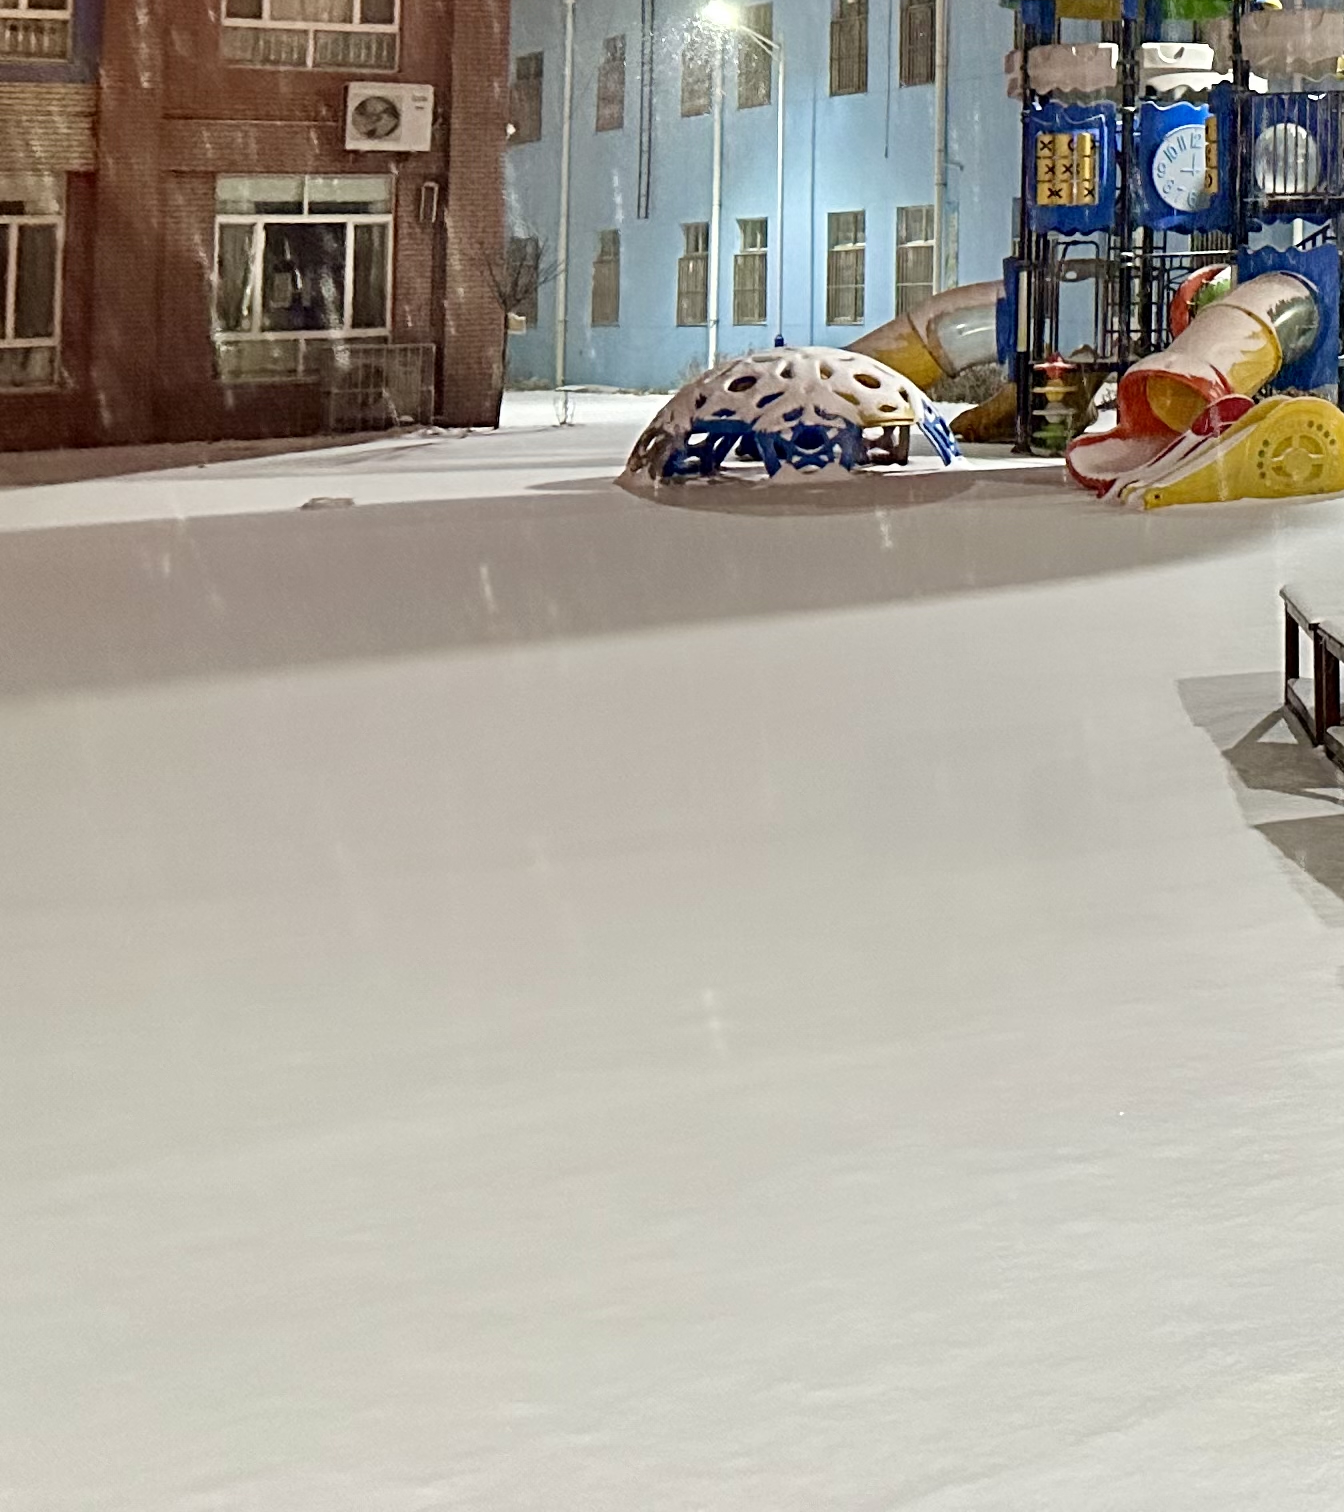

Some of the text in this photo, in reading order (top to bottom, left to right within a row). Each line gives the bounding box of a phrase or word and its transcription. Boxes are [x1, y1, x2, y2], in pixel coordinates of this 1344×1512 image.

[1176, 135, 1187, 152] 11
[1190, 132, 1203, 149] 12
[1163, 145, 1178, 163] 10
